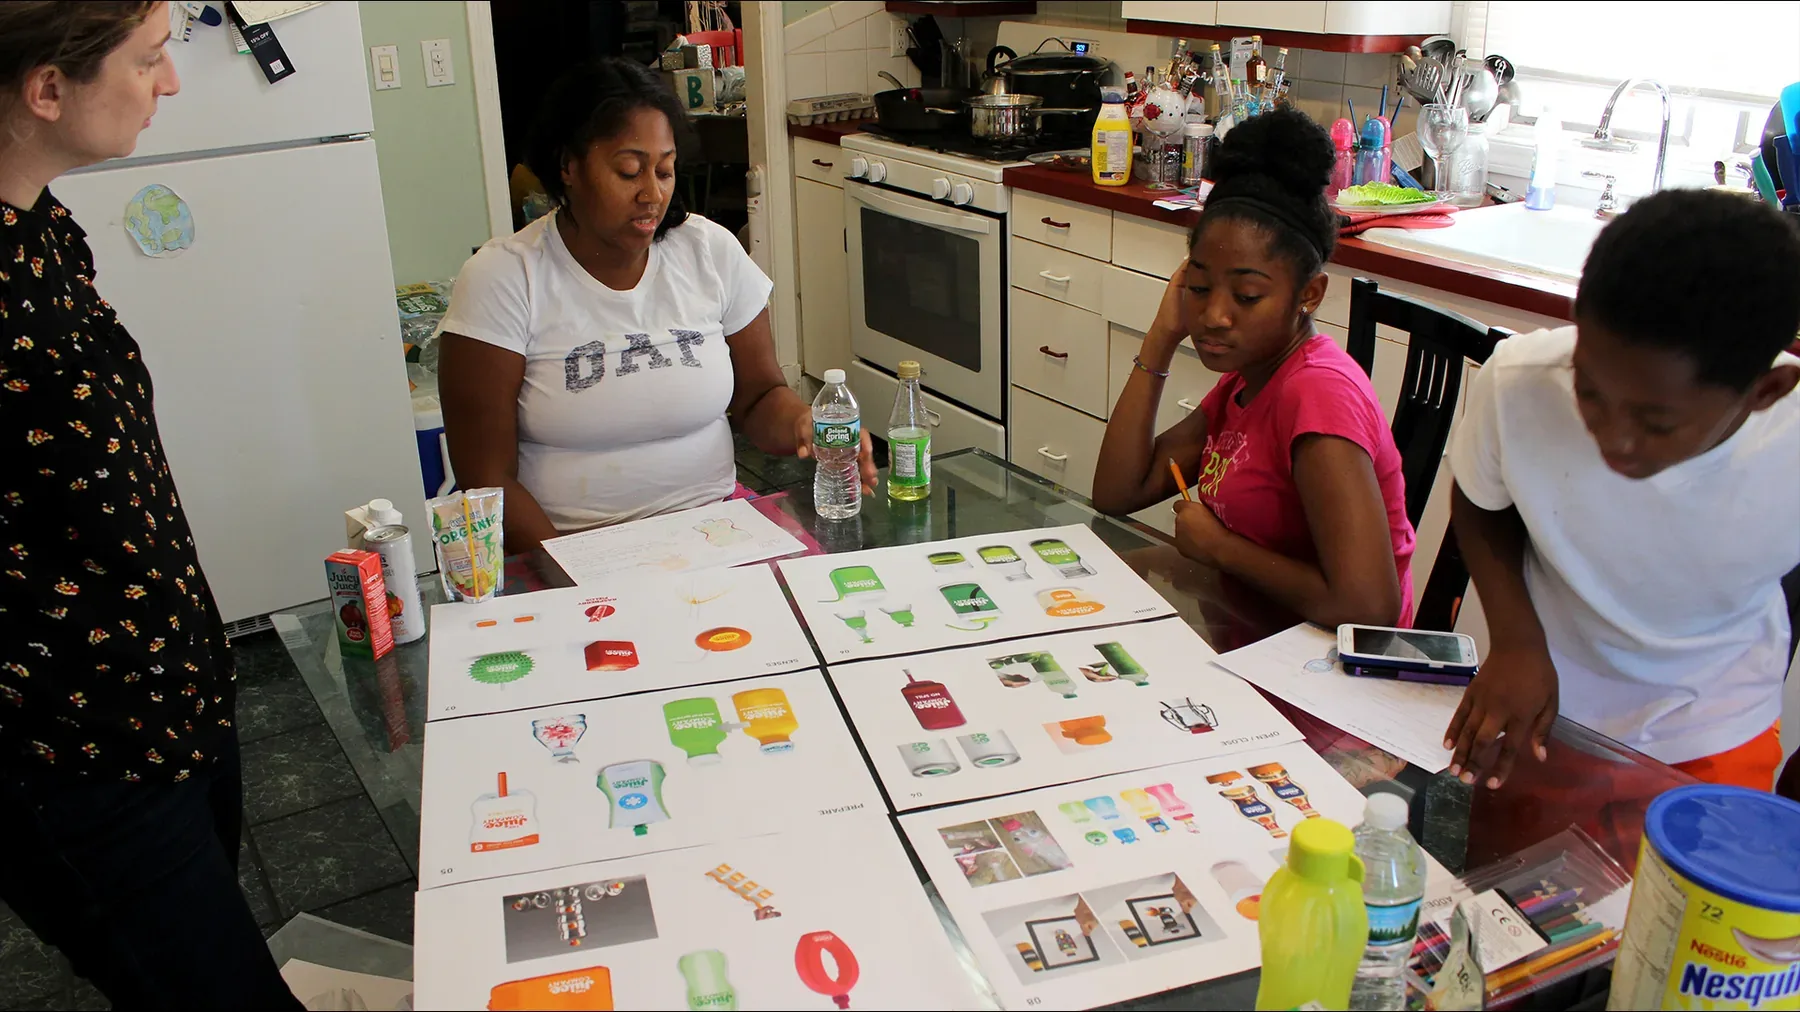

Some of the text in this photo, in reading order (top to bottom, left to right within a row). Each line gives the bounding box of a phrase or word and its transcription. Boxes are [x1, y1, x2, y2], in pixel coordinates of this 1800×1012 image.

[687, 75, 704, 108] B
[825, 431, 850, 443] Spring
[439, 513, 497, 545] ORGANIC
[329, 572, 360, 585] Juicy
[333, 582, 359, 590] Juice
[766, 659, 799, 667] SENSES
[916, 700, 951, 710] Juice
[1255, 731, 1280, 739] OPEN
[1220, 737, 1249, 746] CLOSE
[613, 779, 649, 789] Juice
[818, 803, 865, 816] PREPARE
[486, 818, 528, 829] Juice
[440, 867, 453, 875] 05
[1701, 900, 1724, 918] 72
[1689, 937, 1747, 969] Nestlé
[551, 979, 595, 994] Juice
[696, 994, 733, 1008] Juice
[1026, 997, 1042, 1006] 08
